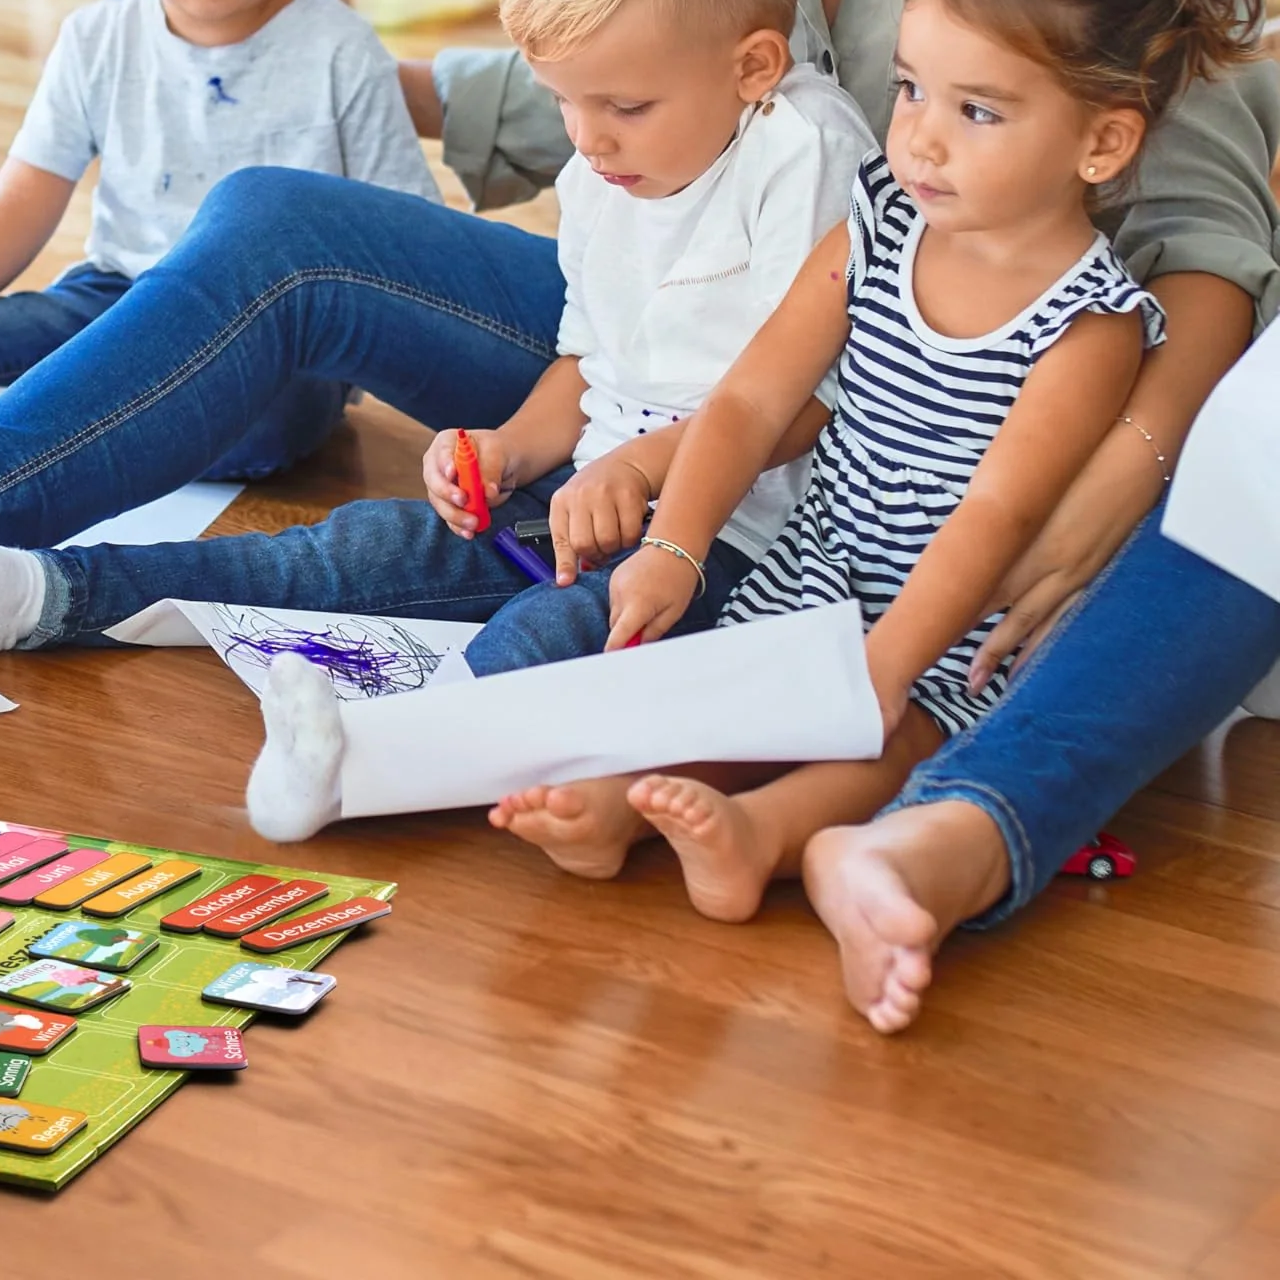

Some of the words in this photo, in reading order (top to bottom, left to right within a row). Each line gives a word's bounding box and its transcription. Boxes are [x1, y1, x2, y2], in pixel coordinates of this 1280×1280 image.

[38, 864, 75, 884] Juni
[83, 869, 115, 888] Juli
[116, 871, 175, 901] August
[189, 882, 256, 916] Oktober
[226, 885, 307, 927] November
[262, 902, 368, 942] Dezember
[38, 924, 80, 952] Sommer
[217, 966, 247, 991] Winter
[31, 1022, 67, 1043] Wind
[224, 1030, 242, 1059] Schnee
[31, 1115, 76, 1143] Regen
